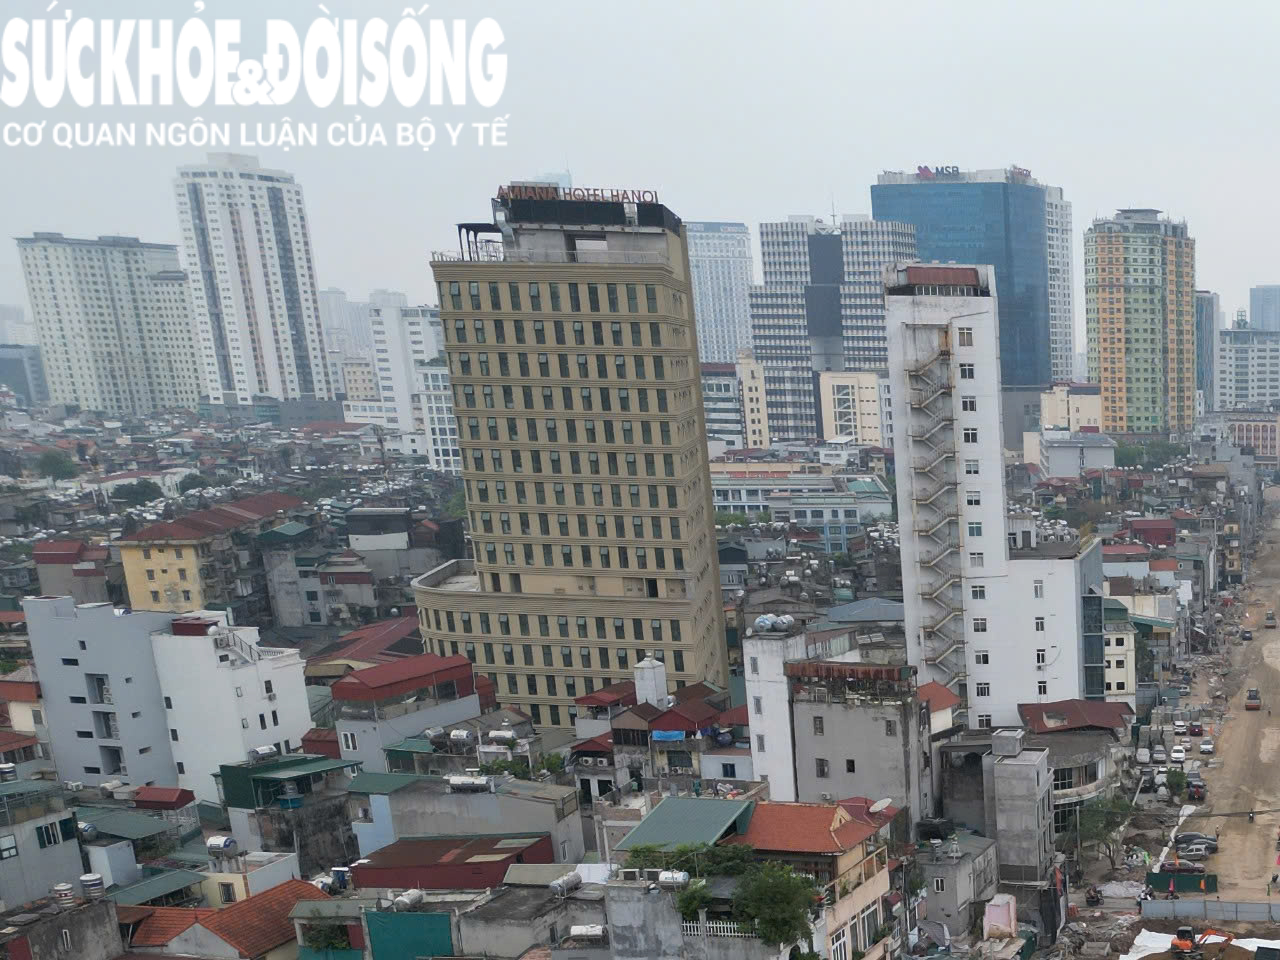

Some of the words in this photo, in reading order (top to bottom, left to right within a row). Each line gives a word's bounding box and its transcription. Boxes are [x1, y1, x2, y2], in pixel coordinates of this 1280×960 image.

[935, 166, 960, 177] MSB
[497, 185, 560, 201] AMIANA
[563, 187, 606, 203] HOTEL
[610, 190, 660, 204] HANOI
